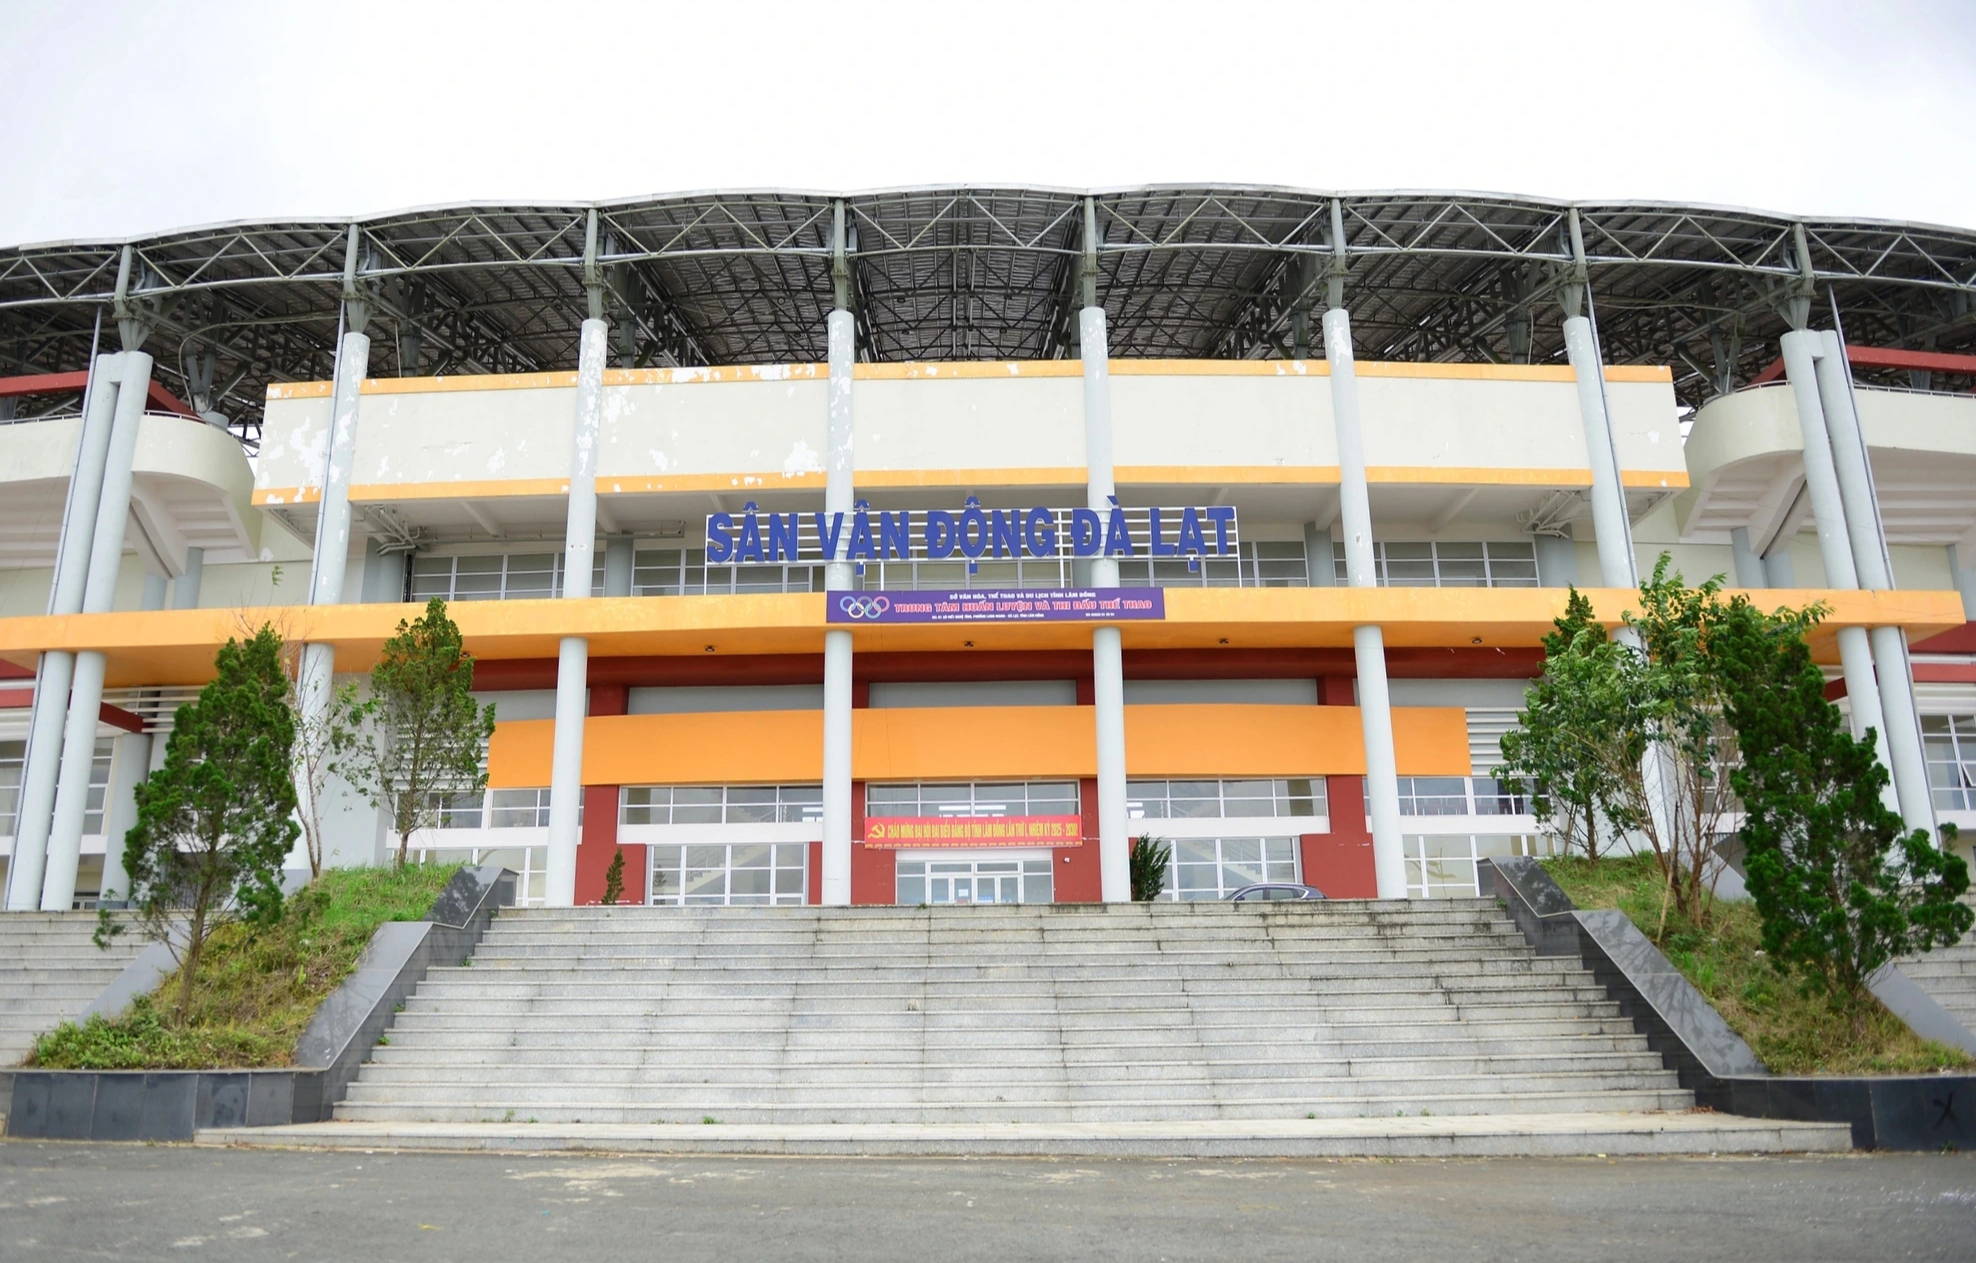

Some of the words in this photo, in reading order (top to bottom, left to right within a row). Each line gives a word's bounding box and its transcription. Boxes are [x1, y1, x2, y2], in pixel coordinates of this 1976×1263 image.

[708, 501, 798, 563] SÂN
[815, 499, 909, 577] VẬN
[925, 496, 1055, 575] ĐỘNG
[1071, 496, 1133, 557] ĐÀ
[1150, 507, 1235, 572] LẠT
[894, 603, 932, 613] TRUNG
[935, 601, 960, 612] TÂM
[962, 599, 994, 612] HUẤN
[996, 601, 1032, 612] LUYỆN
[1034, 600, 1050, 611] VÀ
[1052, 600, 1070, 610] THI
[1073, 598, 1096, 610] ĐẤU
[1099, 597, 1121, 609] THỂ
[1122, 600, 1152, 610] THAO
